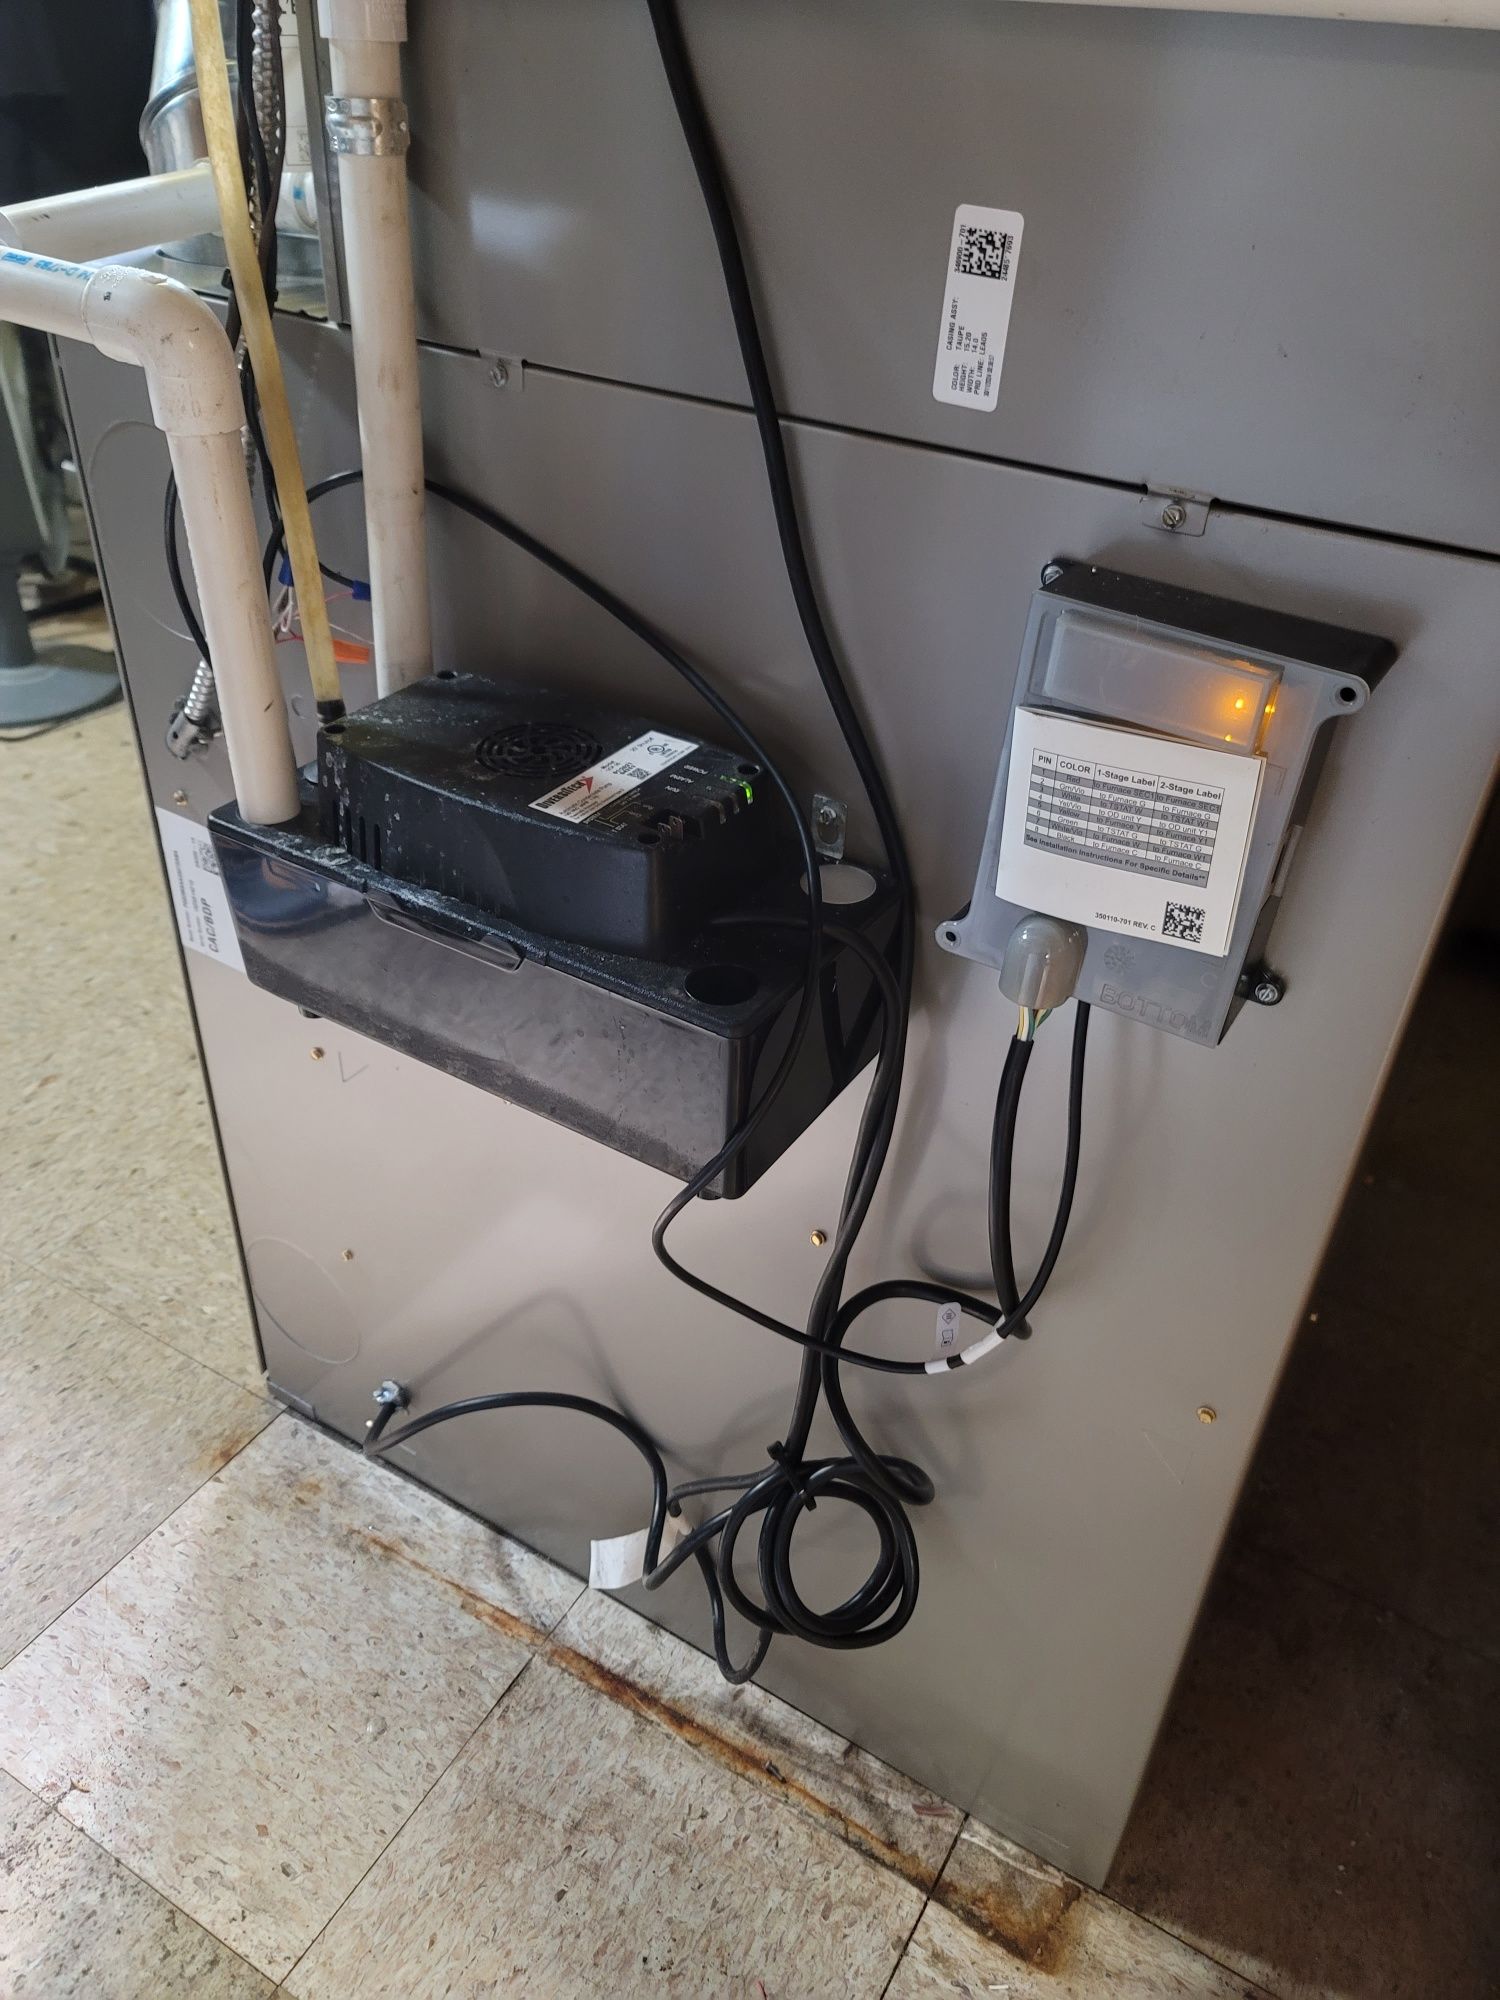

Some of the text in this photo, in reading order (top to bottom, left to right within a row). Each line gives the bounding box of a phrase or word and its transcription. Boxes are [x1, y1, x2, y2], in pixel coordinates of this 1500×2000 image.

[946, 297, 960, 350] CASING ASSY:
[956, 325, 965, 350] TAUPE
[964, 332, 972, 352] 15.20
[976, 358, 984, 378] LINE:
[951, 364, 960, 390] COLOR:
[959, 362, 967, 392] HEIGHT:
[966, 366, 975, 393] WIDTH:
[1038, 755, 1052, 764] PIN
[1060, 761, 1090, 774] COLOR
[1097, 769, 1155, 786] 1-Stage Label
[1102, 783, 1132, 795] Furnace
[1134, 789, 1155, 800] SEC1
[1160, 782, 1221, 800] 2-Stage Label
[1108, 794, 1137, 806] Furnace
[1165, 795, 1196, 807] Furnace
[1198, 802, 1220, 812] SEC1
[1109, 802, 1132, 813] TSTAT
[1172, 806, 1202, 818] Furnace
[1121, 813, 1134, 821] unit
[1170, 814, 1195, 825] TSTAT
[1106, 818, 1134, 829] Furnace
[1106, 826, 1129, 837] TSTAT
[1166, 830, 1196, 842] Furnace
[1182, 826, 1196, 834] unit
[1102, 834, 1131, 846] Furnace
[1168, 839, 1193, 850] TSTAT
[1102, 843, 1129, 854] Furnace
[1162, 847, 1191, 859] Furnace
[1039, 837, 1078, 854] Installation
[1078, 848, 1123, 865] Instructions
[1124, 859, 1138, 868] For
[1140, 862, 1170, 875] Specific
[1163, 856, 1193, 867] Furnace
[201, 897, 219, 953] CAC/BDP
[1095, 912, 1131, 925] 350110-701
[1133, 920, 1148, 930] REV.
